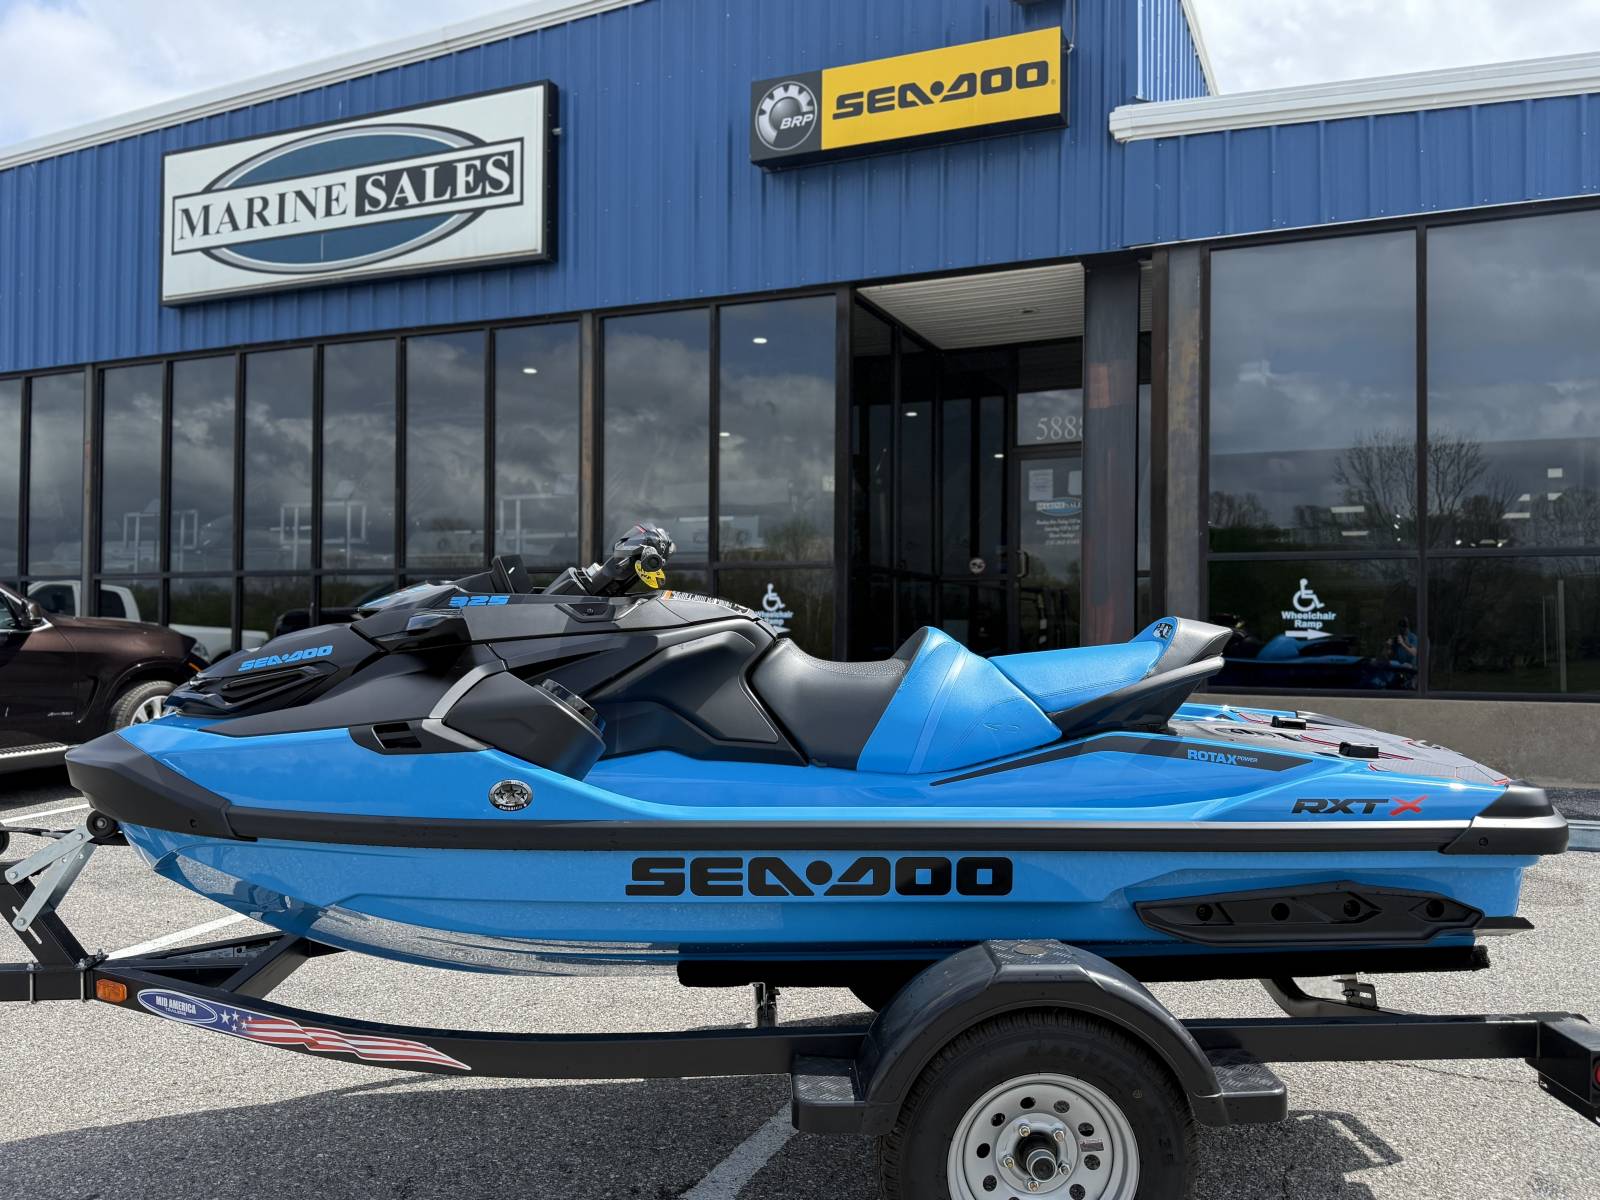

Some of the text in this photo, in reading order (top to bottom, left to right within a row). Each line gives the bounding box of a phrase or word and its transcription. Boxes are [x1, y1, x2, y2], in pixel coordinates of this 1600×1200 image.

[779, 113, 814, 131] BRP
[178, 153, 512, 240] MARINE SALES
[1036, 416, 1082, 440] 588
[448, 595, 510, 608] 325
[1281, 611, 1336, 620] Wheelchair
[1294, 620, 1323, 630] Ramp
[1187, 749, 1258, 765] ROTAX POWER
[1291, 798, 1389, 815] RXT
[155, 995, 197, 1015] MID AMERICA
